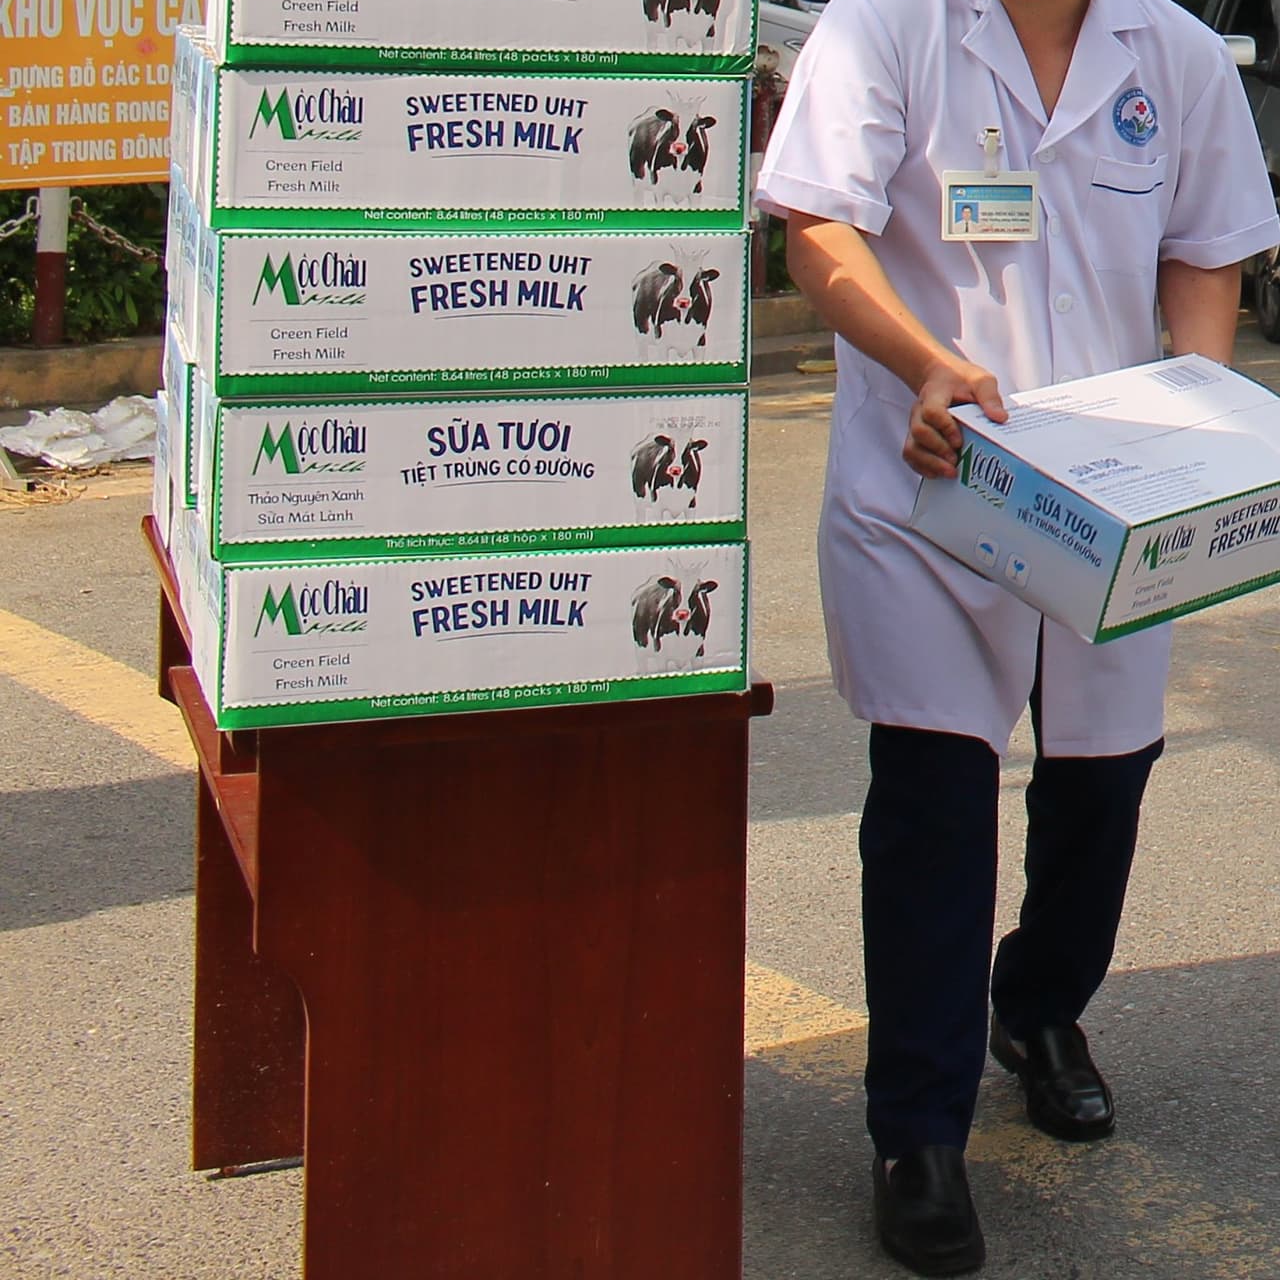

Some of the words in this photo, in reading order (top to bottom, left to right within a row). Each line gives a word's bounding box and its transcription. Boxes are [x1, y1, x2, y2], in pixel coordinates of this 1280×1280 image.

[281, 0, 323, 12] Green
[327, 0, 359, 13] Field
[283, 20, 322, 33] Fresh
[325, 20, 356, 33] Milk
[378, 49, 399, 59] Net
[401, 50, 447, 60] content:
[450, 51, 473, 61] 8.64
[522, 52, 560, 64] packs
[575, 53, 596, 63] 180
[102, 60, 140, 86] CÁC
[56, 98, 110, 125] HÀNG
[116, 100, 169, 123] RONG
[406, 94, 538, 116] SWEETENED
[546, 96, 588, 118] UHT
[407, 119, 504, 152] FRESH
[514, 121, 583, 154] MILK
[8, 138, 46, 170] TẬP
[52, 139, 117, 163] TRUNG
[265, 160, 307, 171] Green
[311, 160, 343, 172] Field
[268, 180, 306, 192] Fresh
[310, 180, 340, 192] Milk
[410, 253, 541, 277] SWEETENED
[549, 254, 592, 276] UHT
[411, 279, 508, 314] FRESH
[518, 280, 588, 311] MILK
[270, 328, 312, 340] Green
[316, 327, 348, 339] Field
[273, 348, 311, 360] Fresh
[315, 348, 345, 360] Milk
[428, 417, 490, 456] SỮA
[498, 419, 571, 452] TƯƠI
[401, 461, 437, 487] TIỆT
[444, 457, 501, 479] TRÙNG
[507, 455, 531, 476] CÓ
[535, 456, 595, 479] ĐƯỜNG
[248, 491, 279, 505] Thảo
[282, 490, 329, 505] Nguyên
[331, 489, 364, 501] Xanh
[288, 511, 316, 523] Mát
[320, 509, 353, 522] Lành
[1033, 492, 1060, 522] SỮA
[1064, 509, 1098, 544] TƯƠI
[1214, 497, 1278, 533] SWEETENED
[458, 536, 479, 545] 8.64
[552, 532, 572, 541] 180
[1208, 522, 1257, 558] FRESH
[411, 572, 543, 602] SWEETENED
[550, 572, 592, 592] UHT
[412, 599, 509, 637] FRESH
[519, 599, 588, 627] MILK
[273, 658, 314, 670] Green
[319, 654, 351, 666] Field
[276, 677, 314, 690] Fresh
[317, 675, 348, 687] Milk
[371, 699, 391, 708] Net
[393, 696, 439, 707] content:
[443, 693, 465, 702] 8.64
[514, 687, 551, 698] packs
[567, 684, 587, 693] 180
